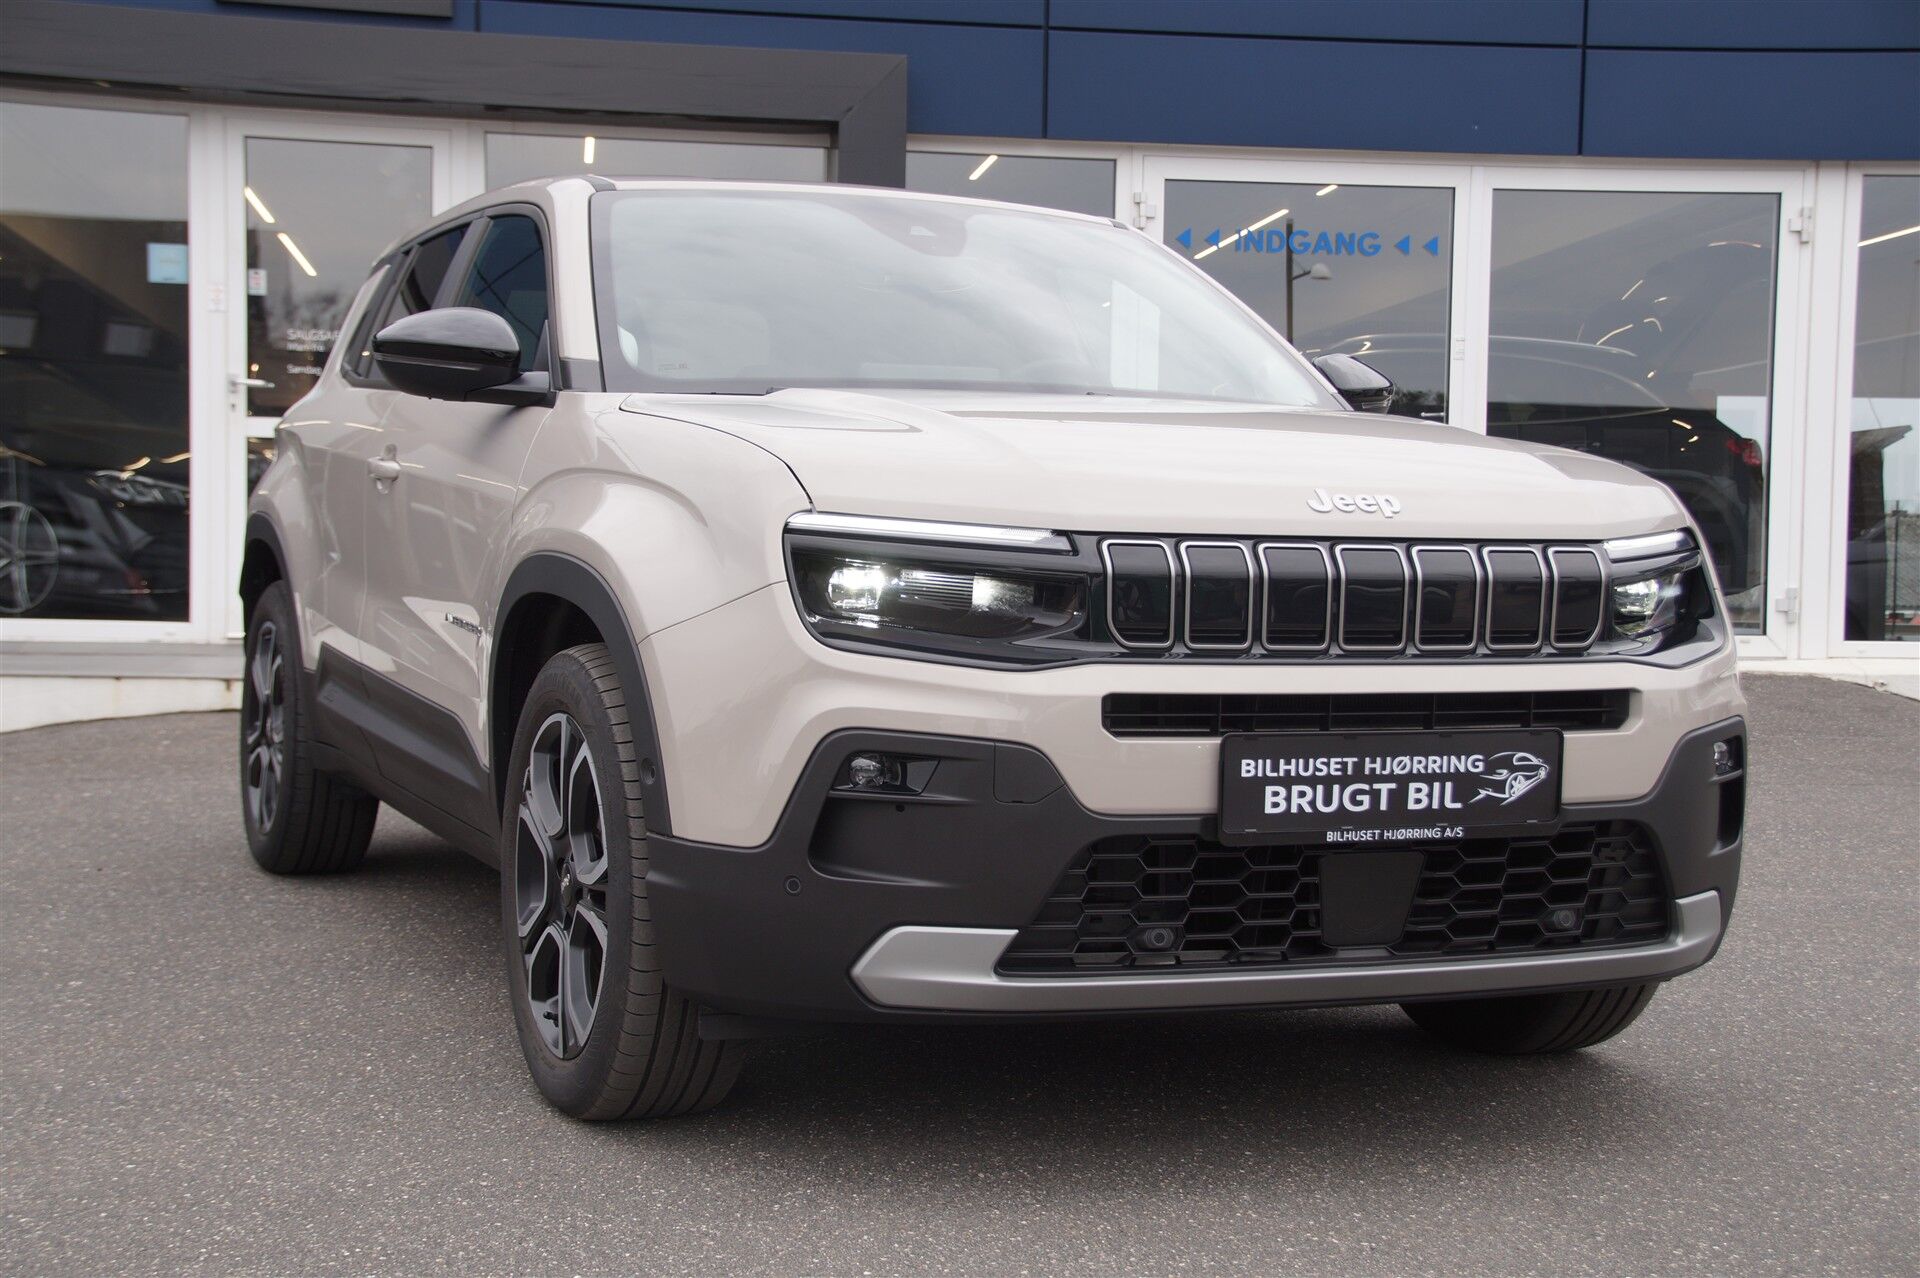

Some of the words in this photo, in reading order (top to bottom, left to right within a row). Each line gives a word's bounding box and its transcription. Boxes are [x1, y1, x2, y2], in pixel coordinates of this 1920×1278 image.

[1234, 229, 1382, 257] INDGANG
[1306, 487, 1401, 519] Jeep
[1240, 757, 1358, 778] BILHUSET
[1364, 754, 1485, 775] HJØRRING
[1264, 782, 1397, 815] BRUGT
[1407, 780, 1463, 811] BIL
[1325, 829, 1381, 842] BILHUSET
[1383, 828, 1442, 841] HJØRRING
[1443, 827, 1464, 839] A/S
